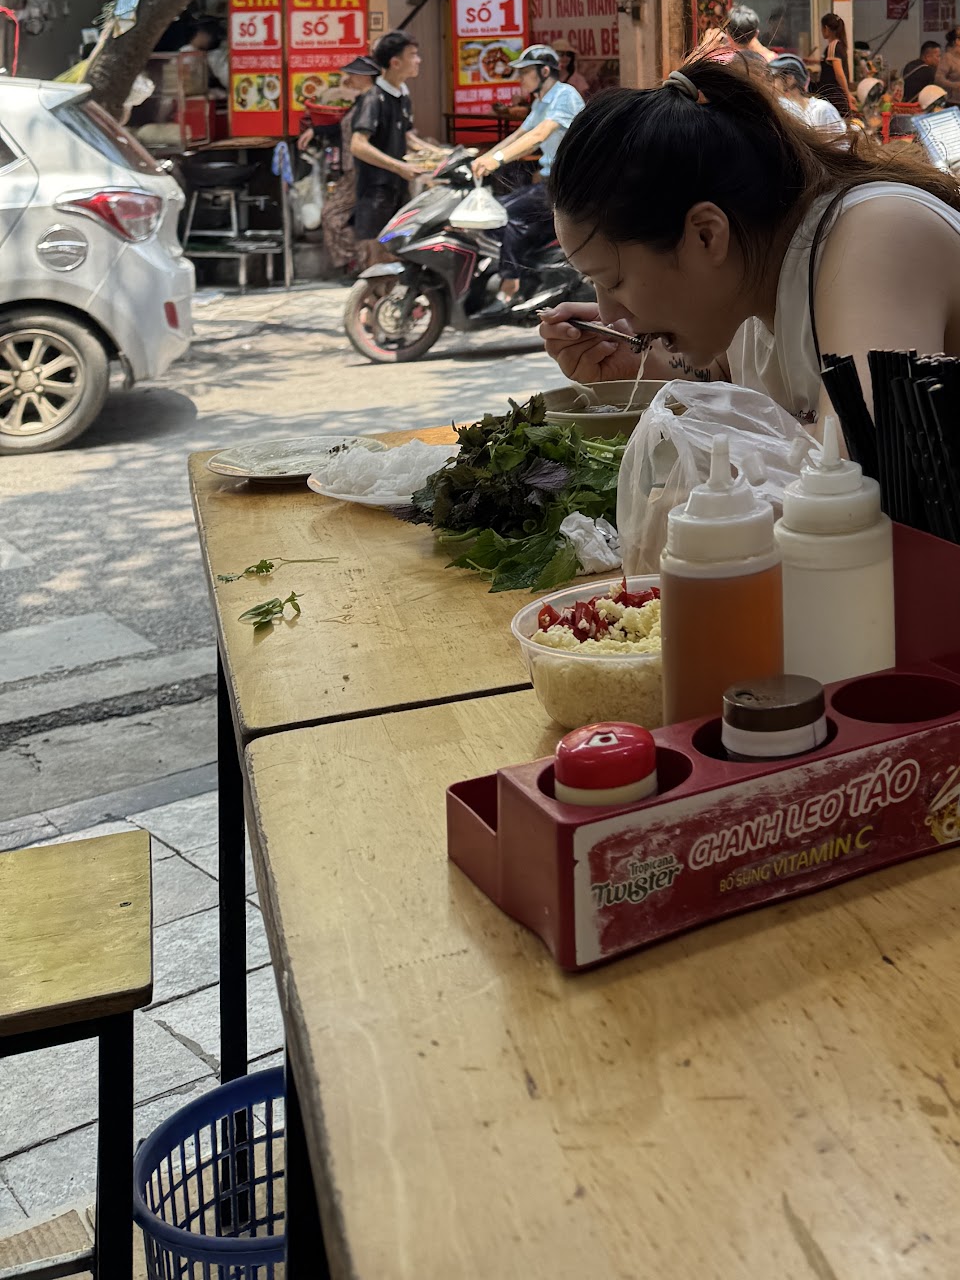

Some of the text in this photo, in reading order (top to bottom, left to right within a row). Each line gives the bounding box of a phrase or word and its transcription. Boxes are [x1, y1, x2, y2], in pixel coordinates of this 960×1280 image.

[466, 0, 492, 23] SỐ
[239, 14, 278, 46] SỐ 1
[302, 13, 361, 45] SỐ 1
[688, 757, 921, 870] CHANH LEO TÁO
[628, 855, 675, 876] Tropicana
[734, 864, 771, 888] SUNG
[772, 833, 852, 877] VITAMIN
[854, 825, 874, 849] C
[591, 866, 683, 908] Twister
